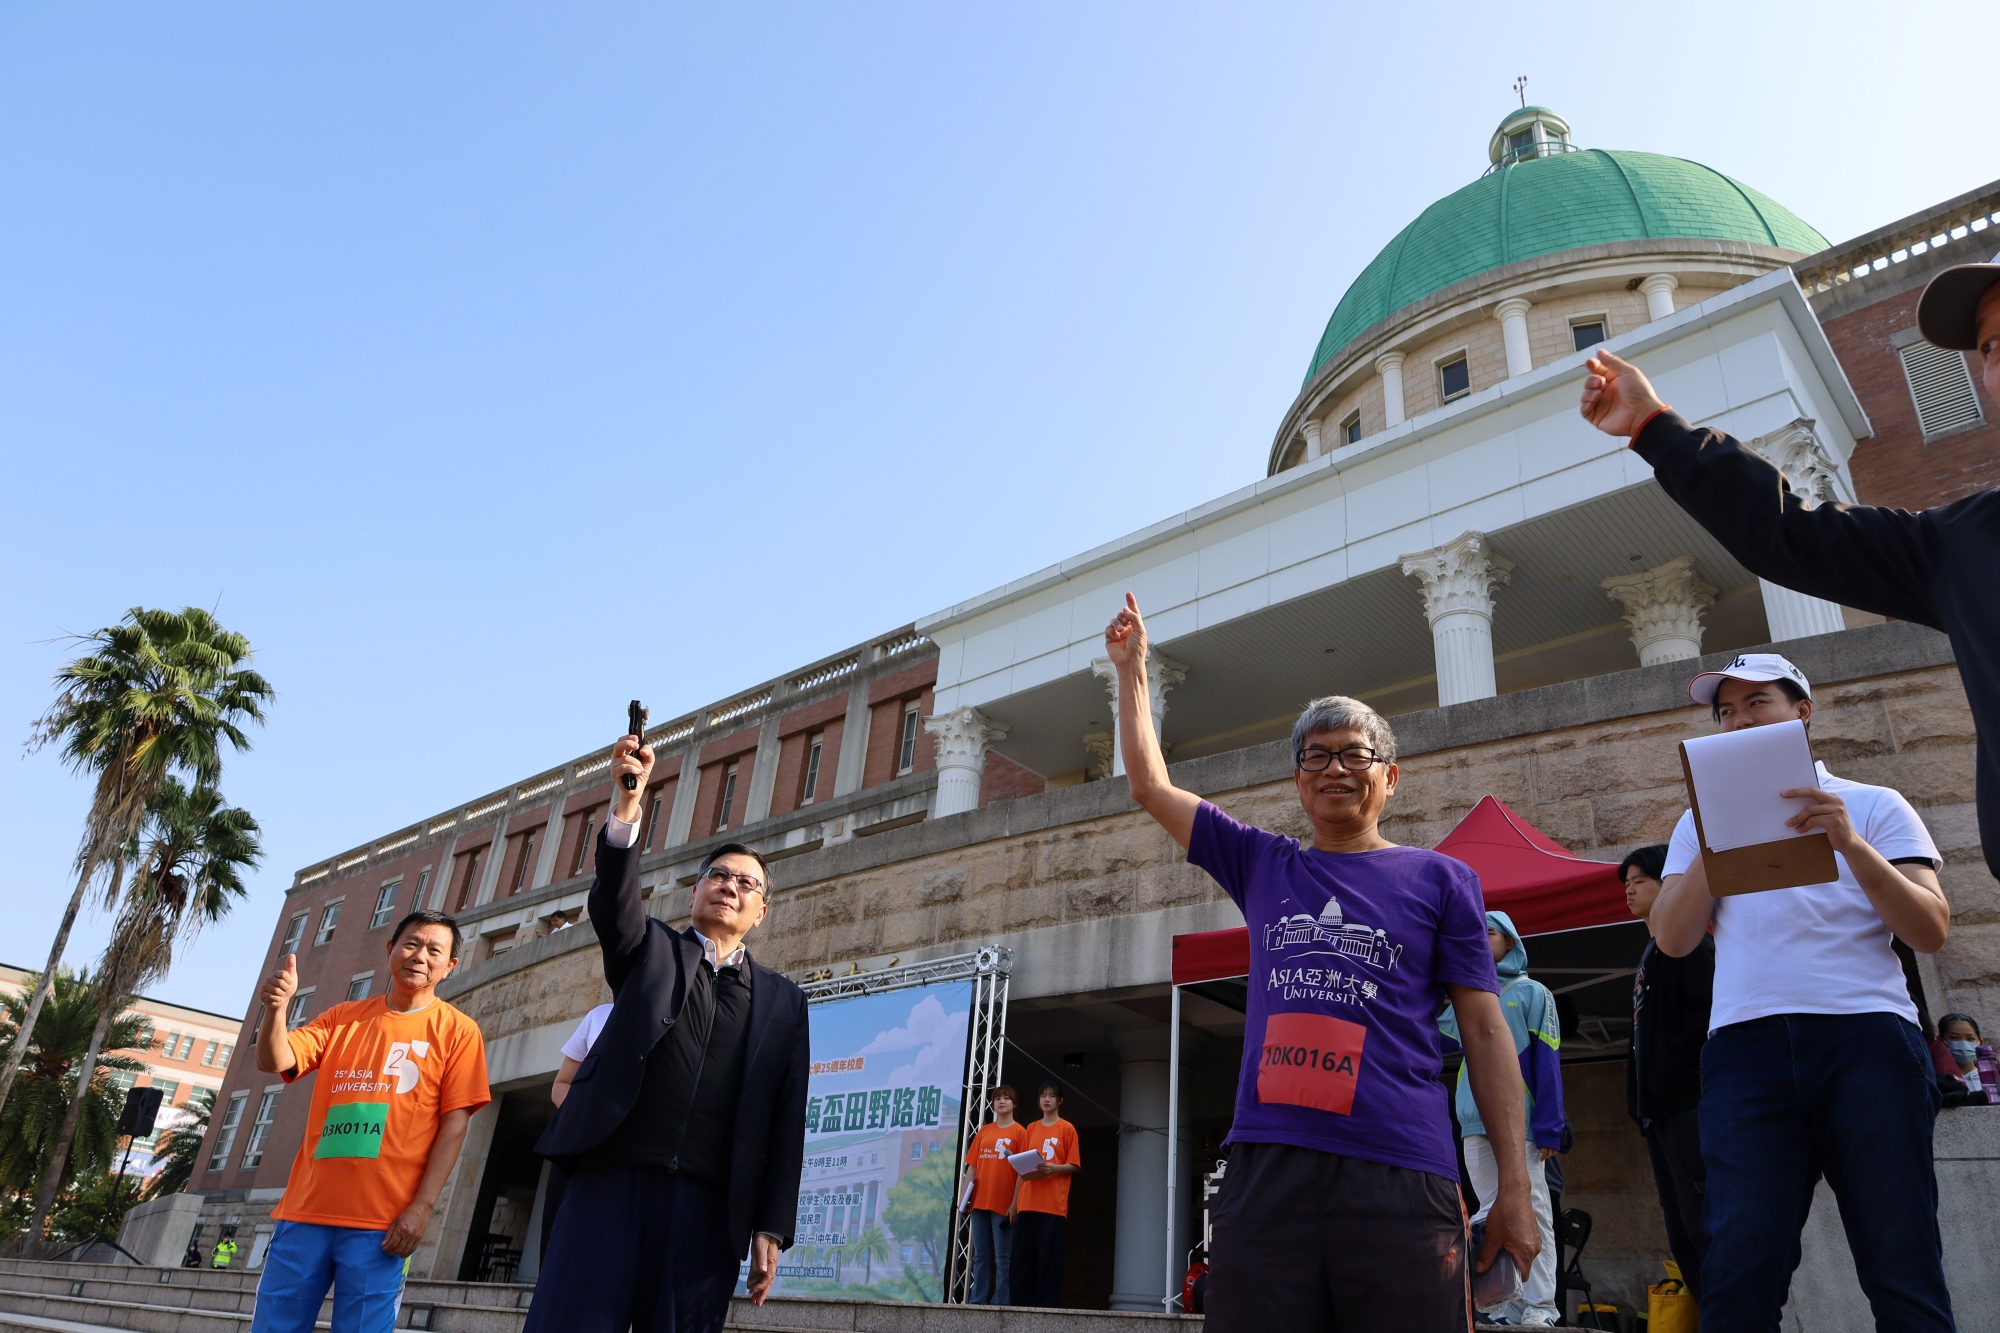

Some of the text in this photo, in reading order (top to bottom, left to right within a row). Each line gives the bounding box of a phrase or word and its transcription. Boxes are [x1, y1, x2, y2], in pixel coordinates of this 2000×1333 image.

[1267, 967, 1304, 991] ASIA
[1304, 969, 1379, 999] 亞洲大學
[1265, 1046, 1354, 1076] 10K016A
[347, 1069, 373, 1079] ASIA
[331, 1082, 392, 1094] UNIVERSITY
[322, 1122, 381, 1138] 03K011A
